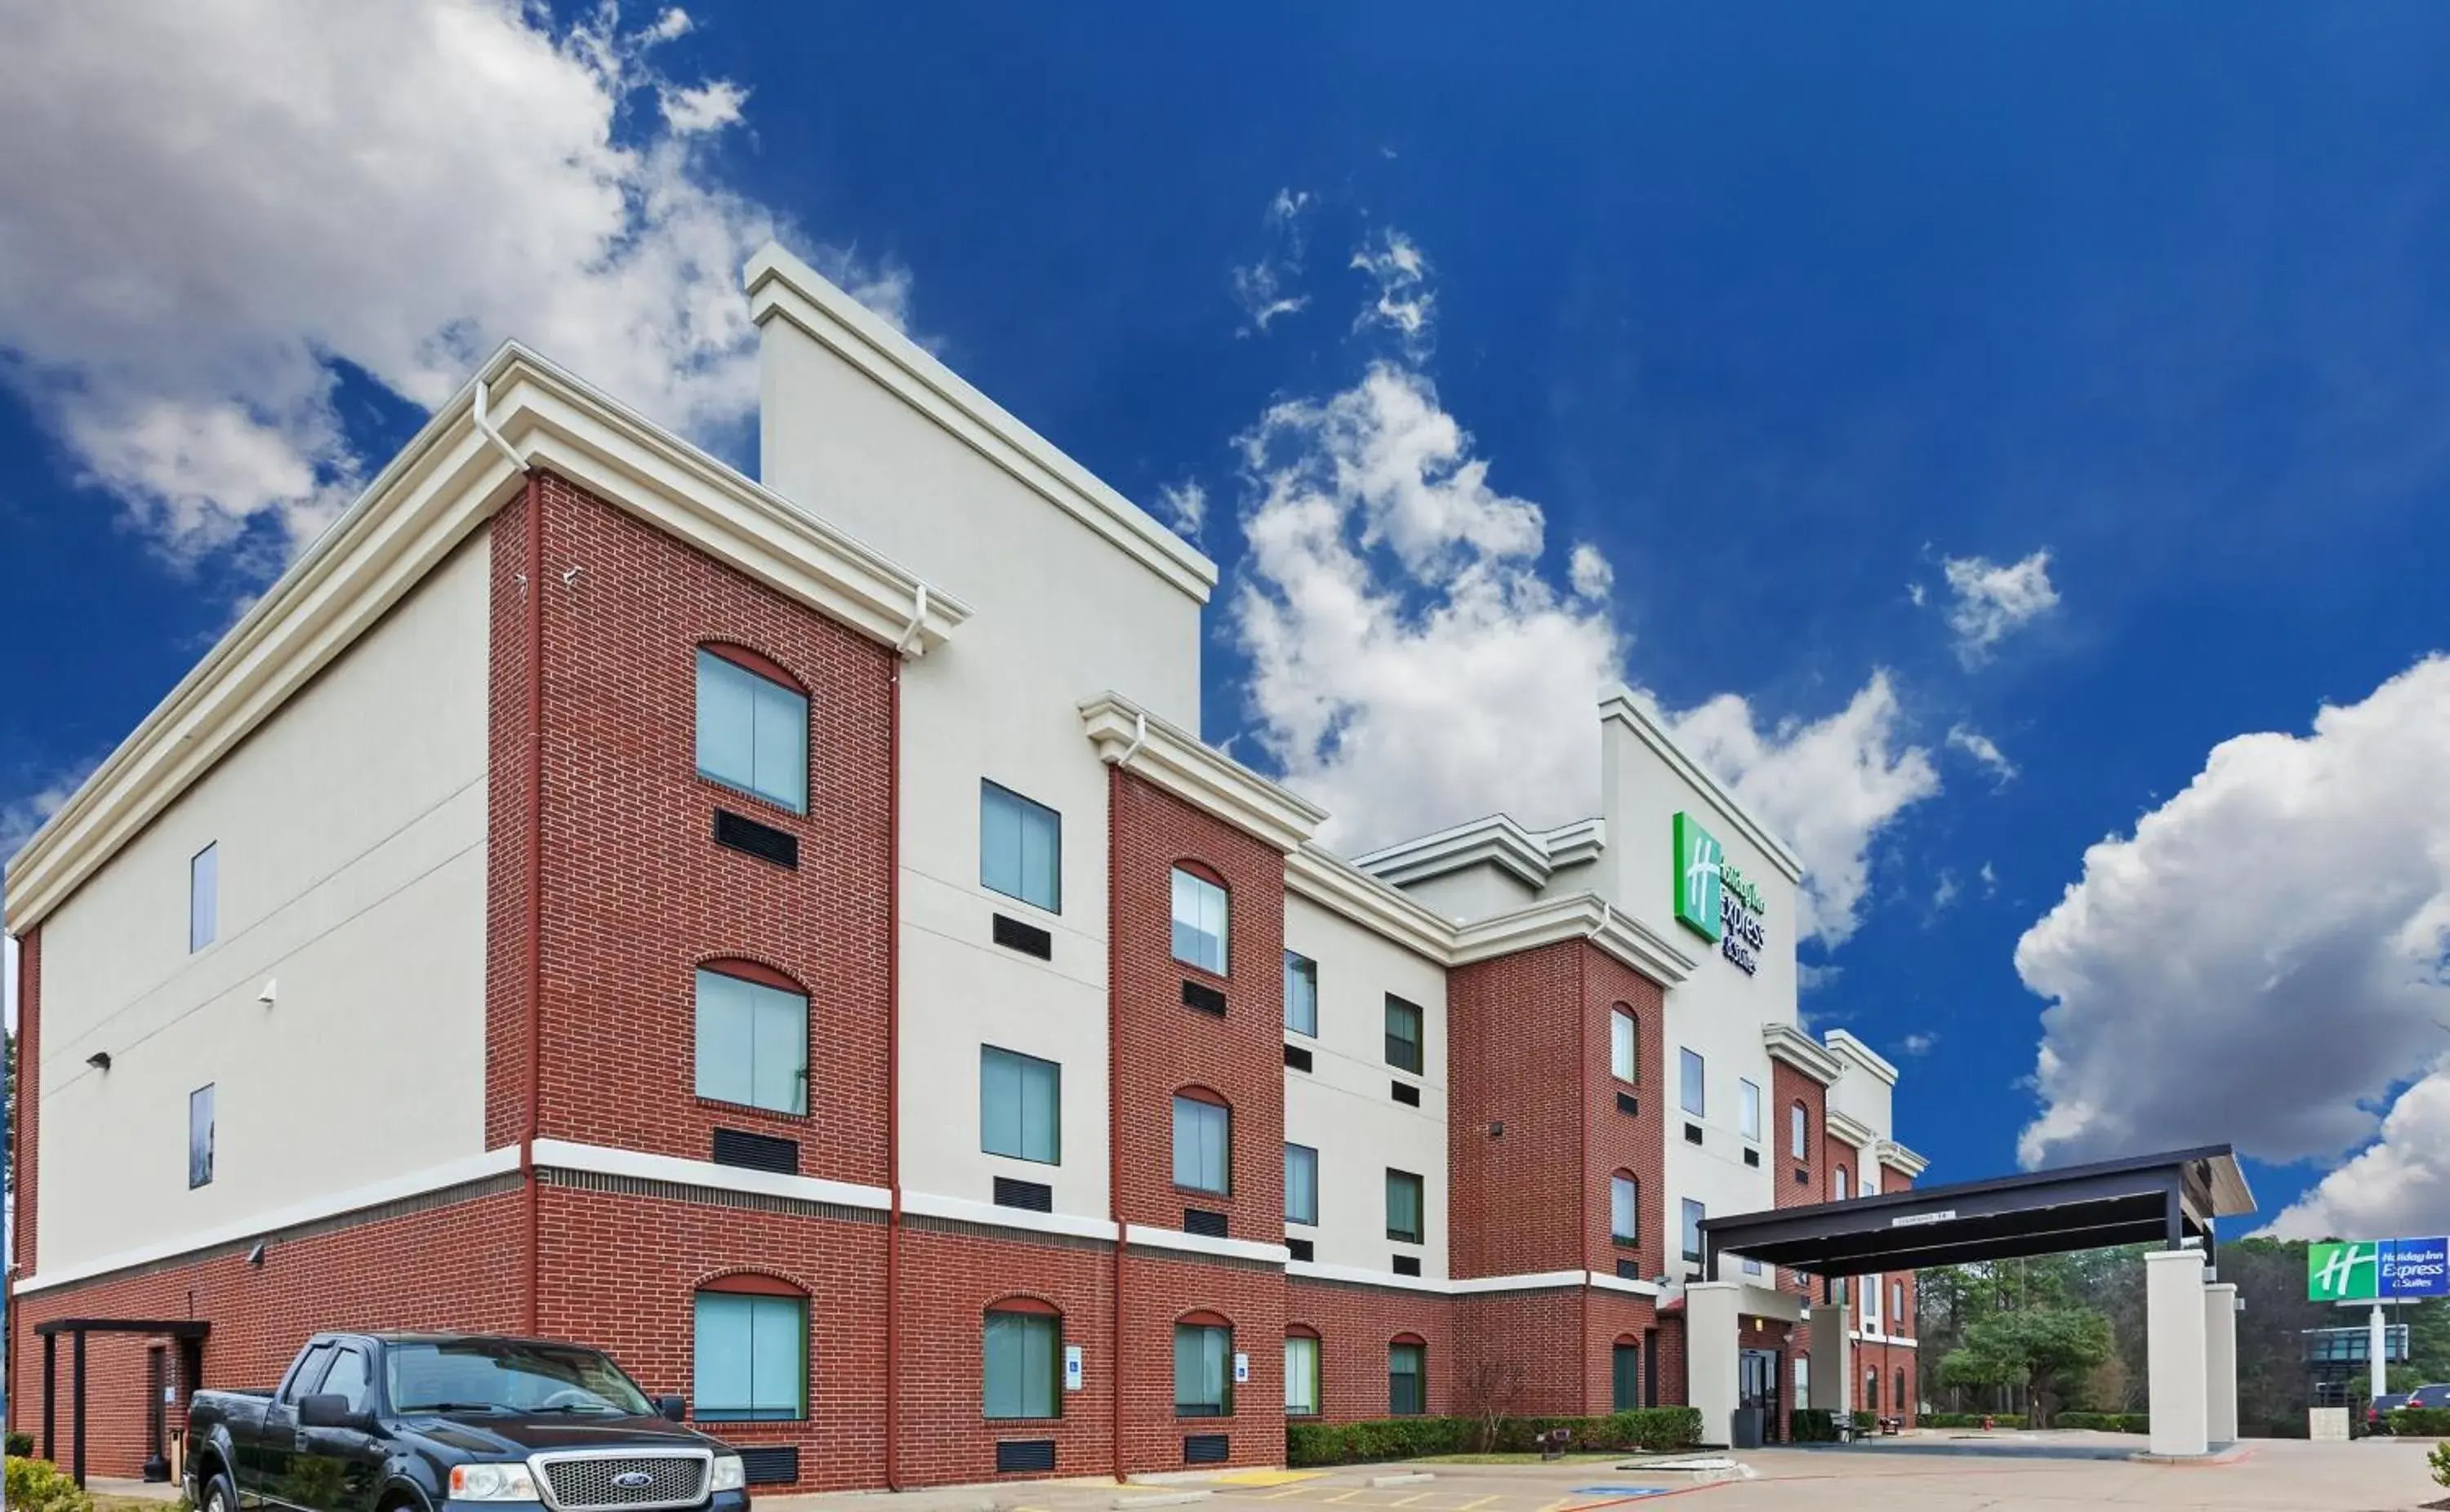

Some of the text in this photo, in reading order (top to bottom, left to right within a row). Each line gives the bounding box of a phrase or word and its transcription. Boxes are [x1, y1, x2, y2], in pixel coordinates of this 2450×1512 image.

[1720, 884, 1765, 949] Express
[2382, 1250, 2444, 1263] Holiday Inn
[2382, 1263, 2444, 1279] Express
[2402, 1279, 2432, 1287] Suites
